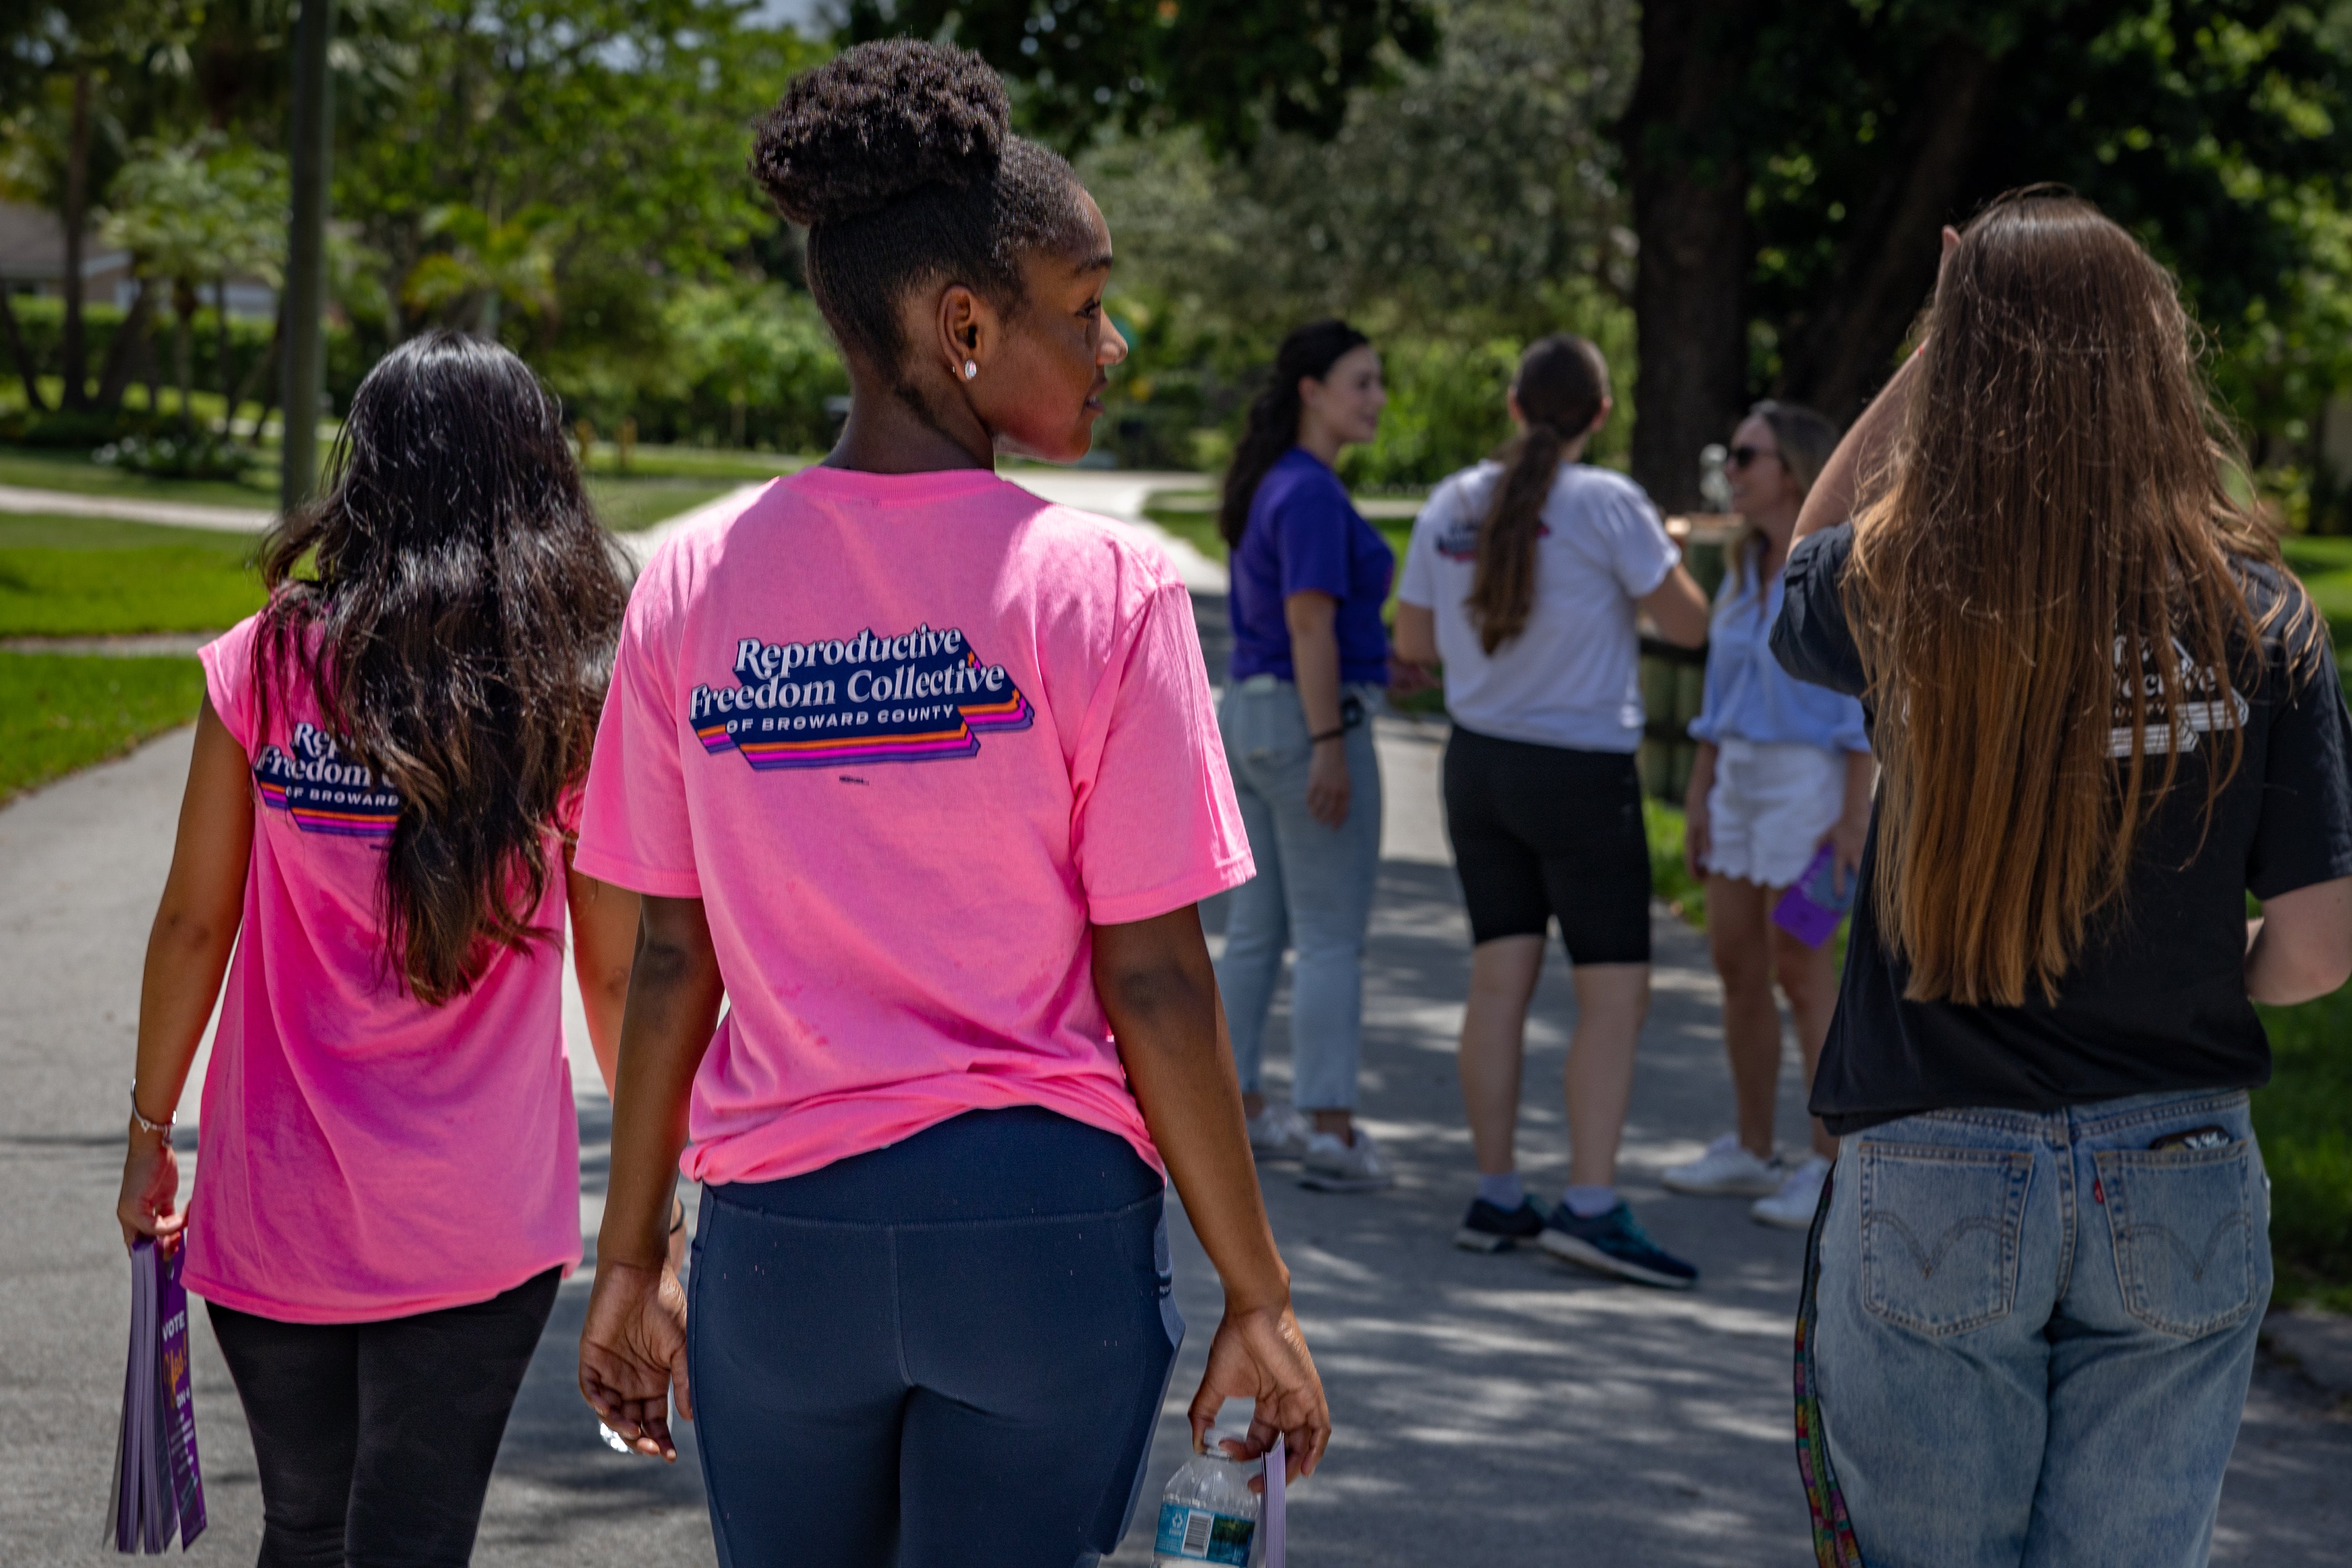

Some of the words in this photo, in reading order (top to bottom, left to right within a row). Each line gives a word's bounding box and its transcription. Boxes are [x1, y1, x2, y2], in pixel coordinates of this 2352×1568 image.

[734, 623, 961, 679] Reproductive
[690, 674, 836, 720] Freedom
[847, 660, 1004, 703] Collective
[726, 719, 753, 734] OF
[762, 711, 869, 731] BROWARD
[877, 704, 954, 724] COUNTY
[285, 786, 304, 798] OF
[309, 788, 400, 807] BROWARD
[162, 1310, 185, 1343] VOTE
[176, 1389, 186, 1410] ON
